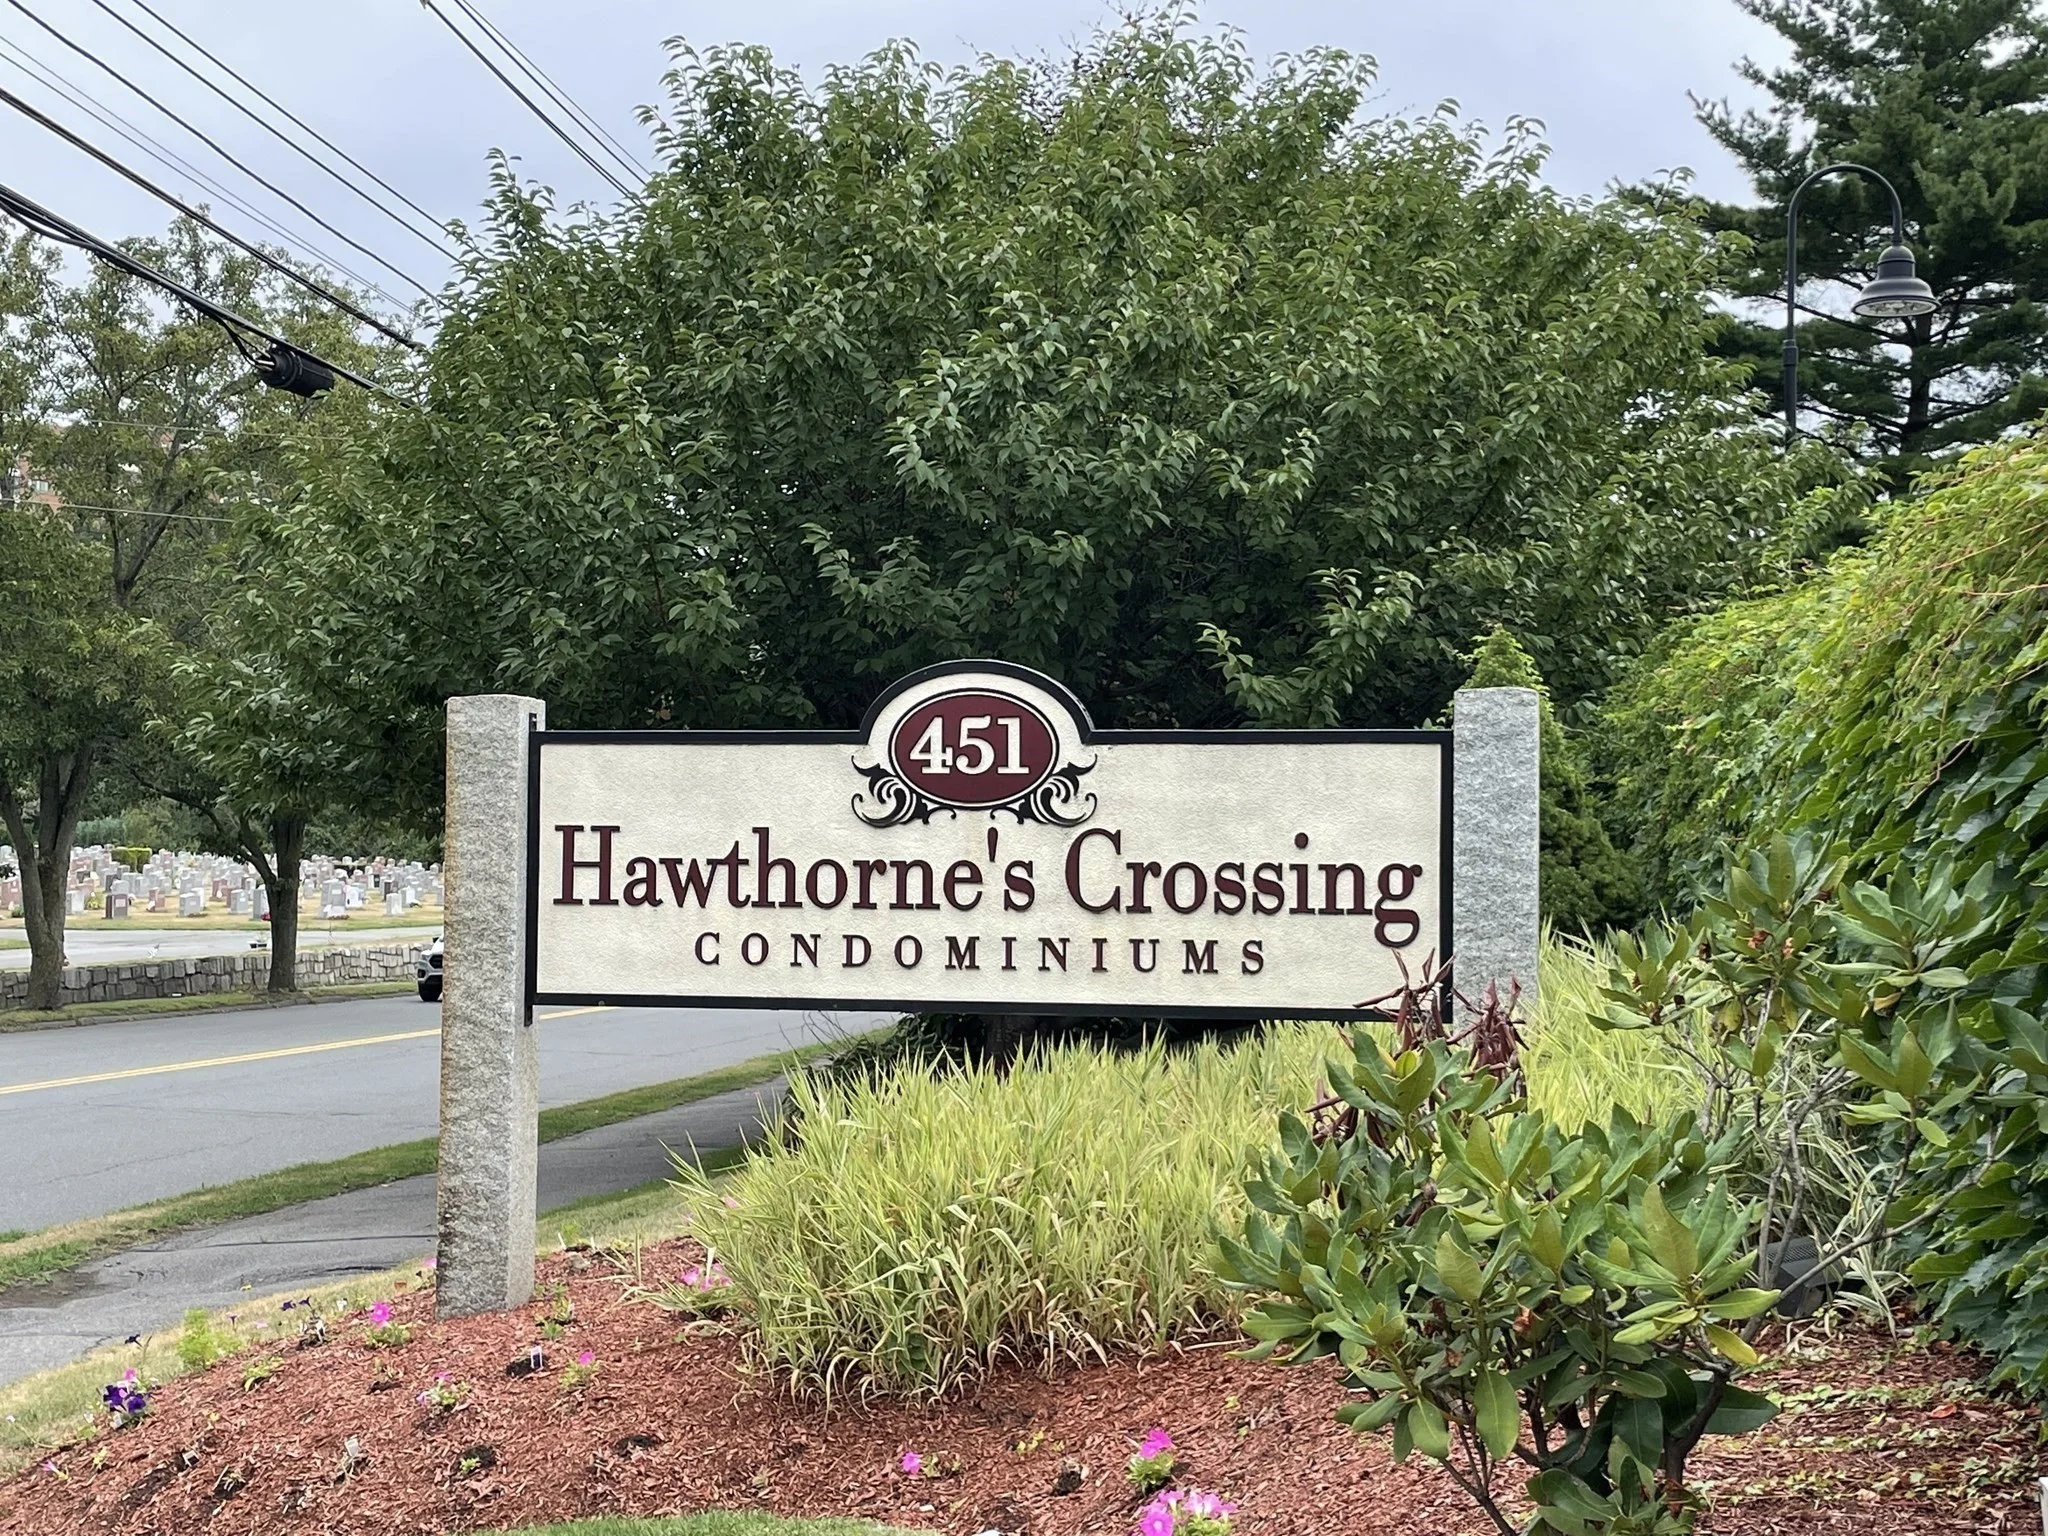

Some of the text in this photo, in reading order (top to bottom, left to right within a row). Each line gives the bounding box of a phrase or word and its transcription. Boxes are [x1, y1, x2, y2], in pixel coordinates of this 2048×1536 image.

[909, 716, 1030, 775] 451
[553, 825, 1423, 947] Hawthorne's Crossing
[695, 932, 1265, 974] CONDOMINIUMS
